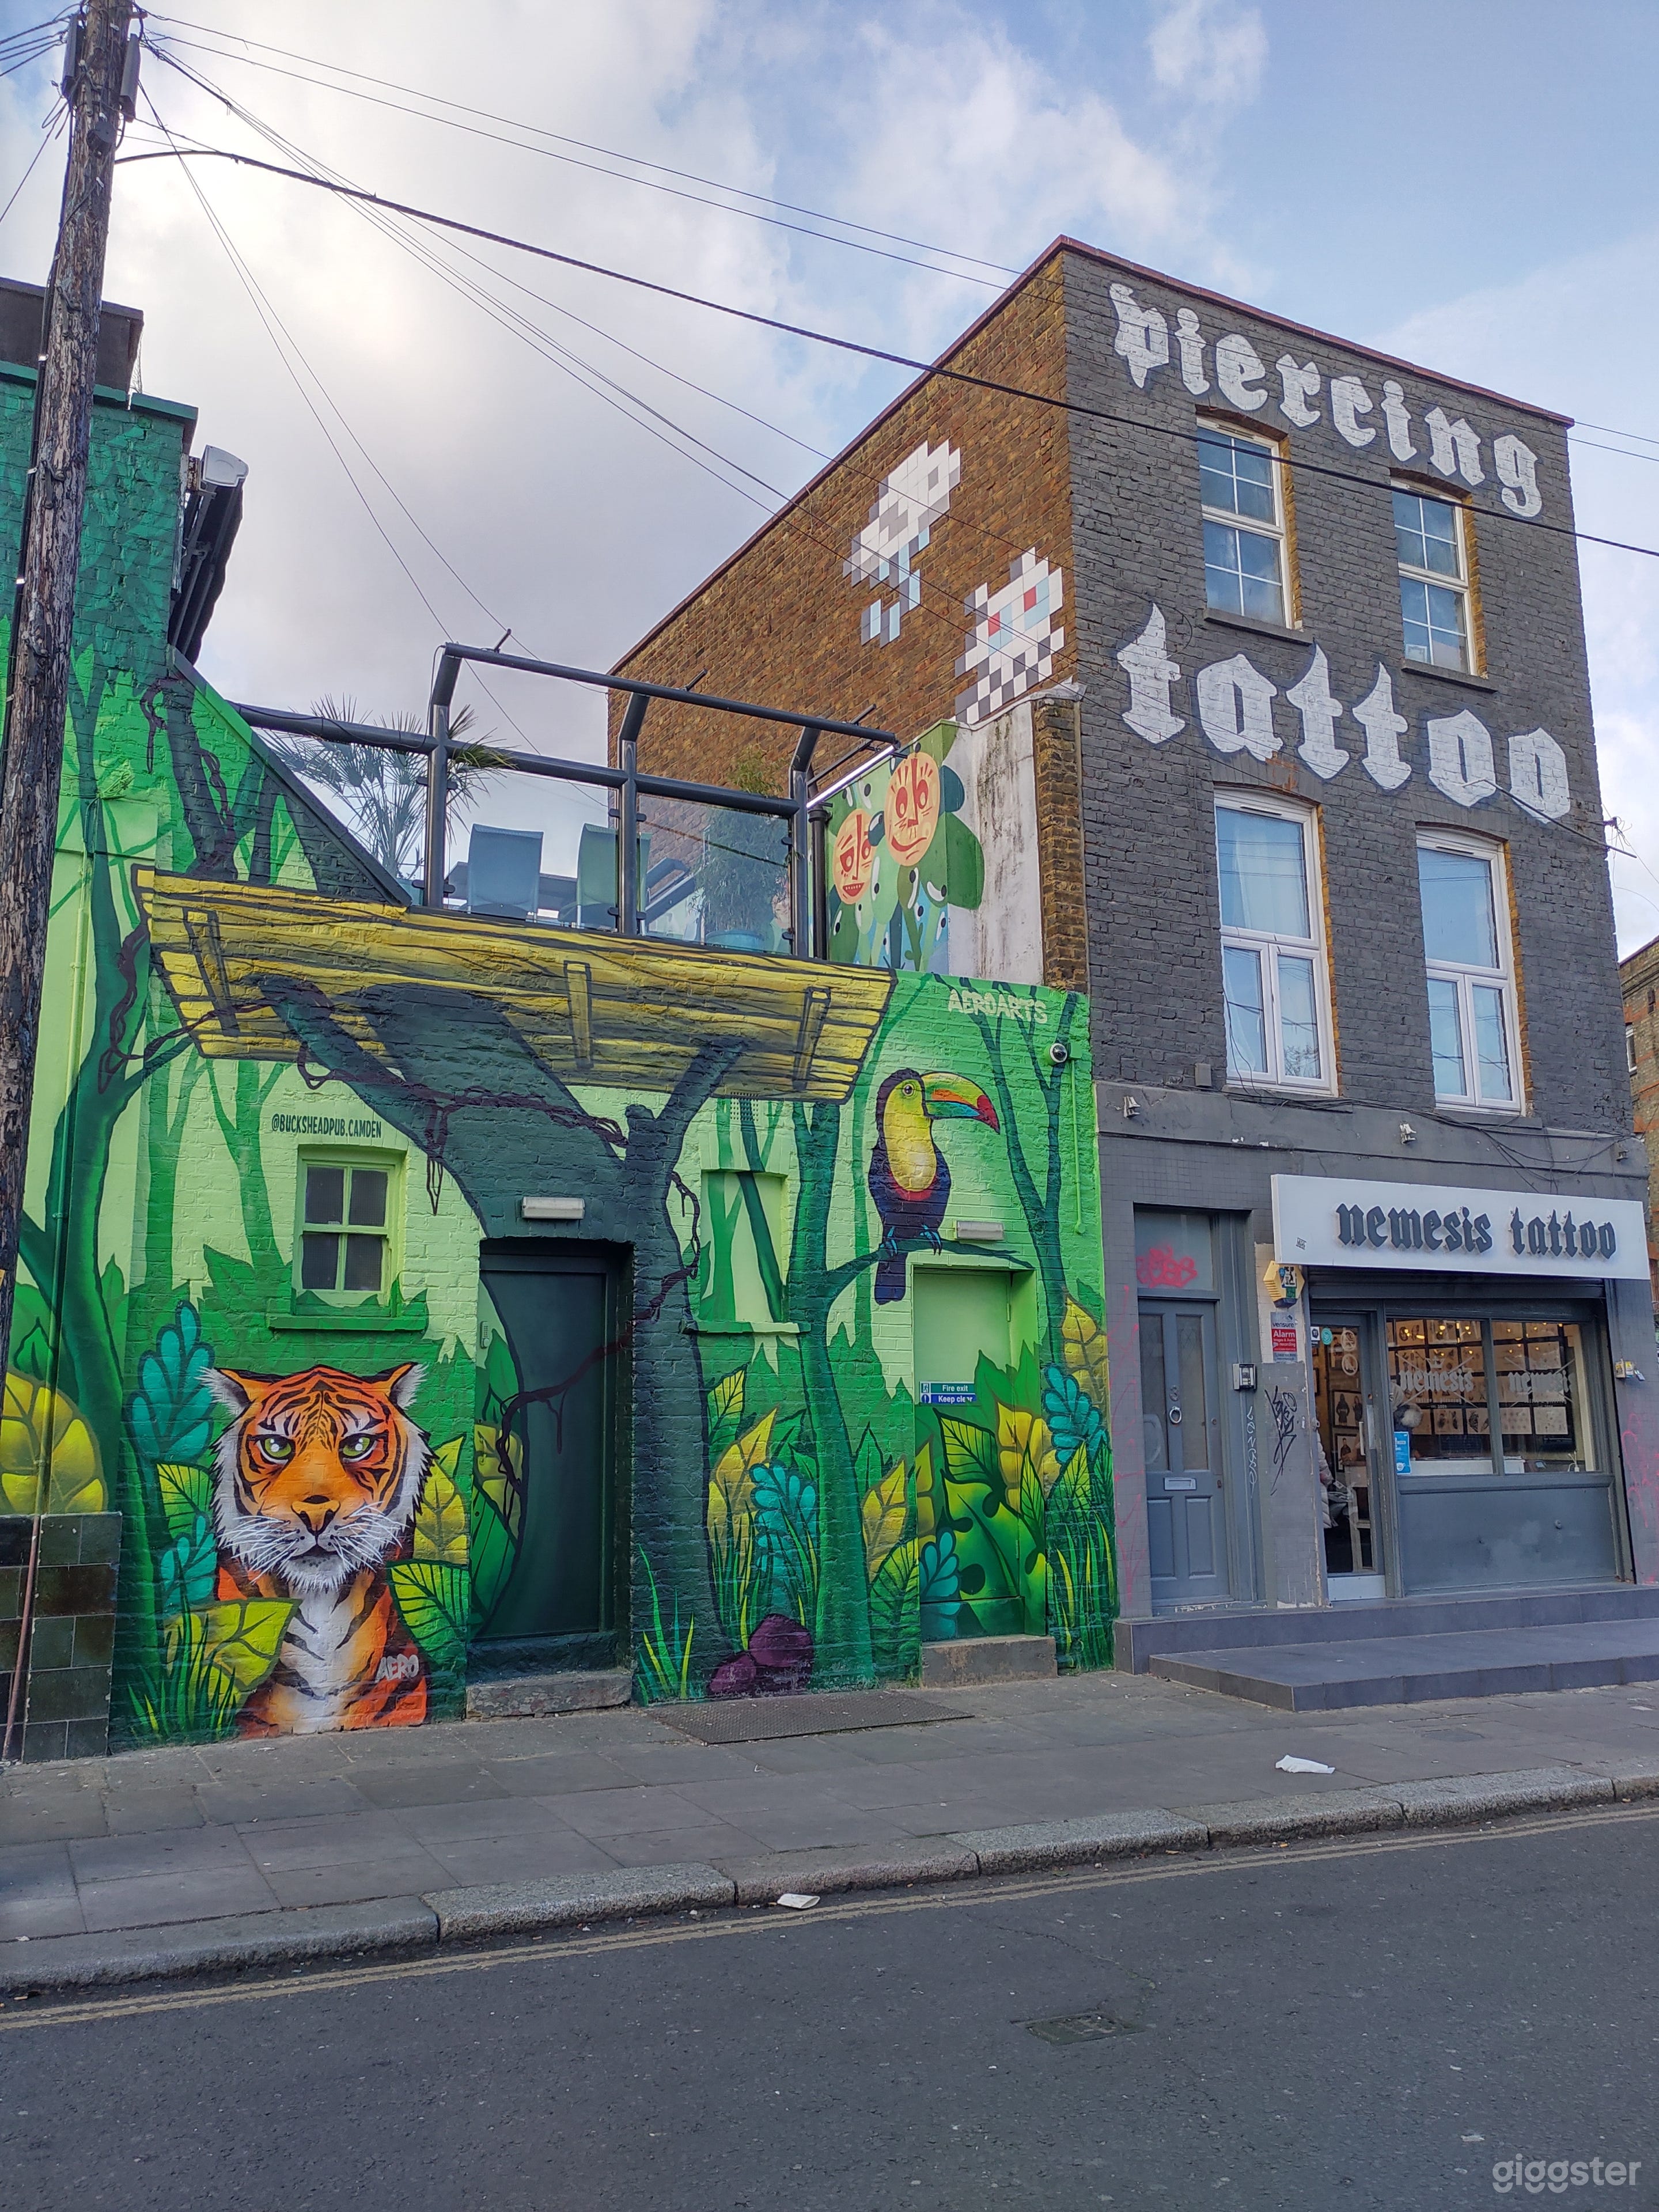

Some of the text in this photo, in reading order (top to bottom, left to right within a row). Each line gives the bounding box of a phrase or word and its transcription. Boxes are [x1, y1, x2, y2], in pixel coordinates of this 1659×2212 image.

[1109, 282, 1543, 518] piercing
[1115, 601, 1571, 824] tattoo
[948, 988, 1048, 1024] AEROARTS
[271, 1113, 381, 1139] @BUCKSHEADPUB.CAMDEN
[1335, 1202, 1617, 1260] nemesis tattoo
[1273, 1330, 1296, 1338] Alarm
[1170, 1385, 1180, 1401] 3
[1399, 1369, 1474, 1392] nemesis
[938, 1395, 955, 1404] Keep
[374, 1653, 419, 1683] AERO
